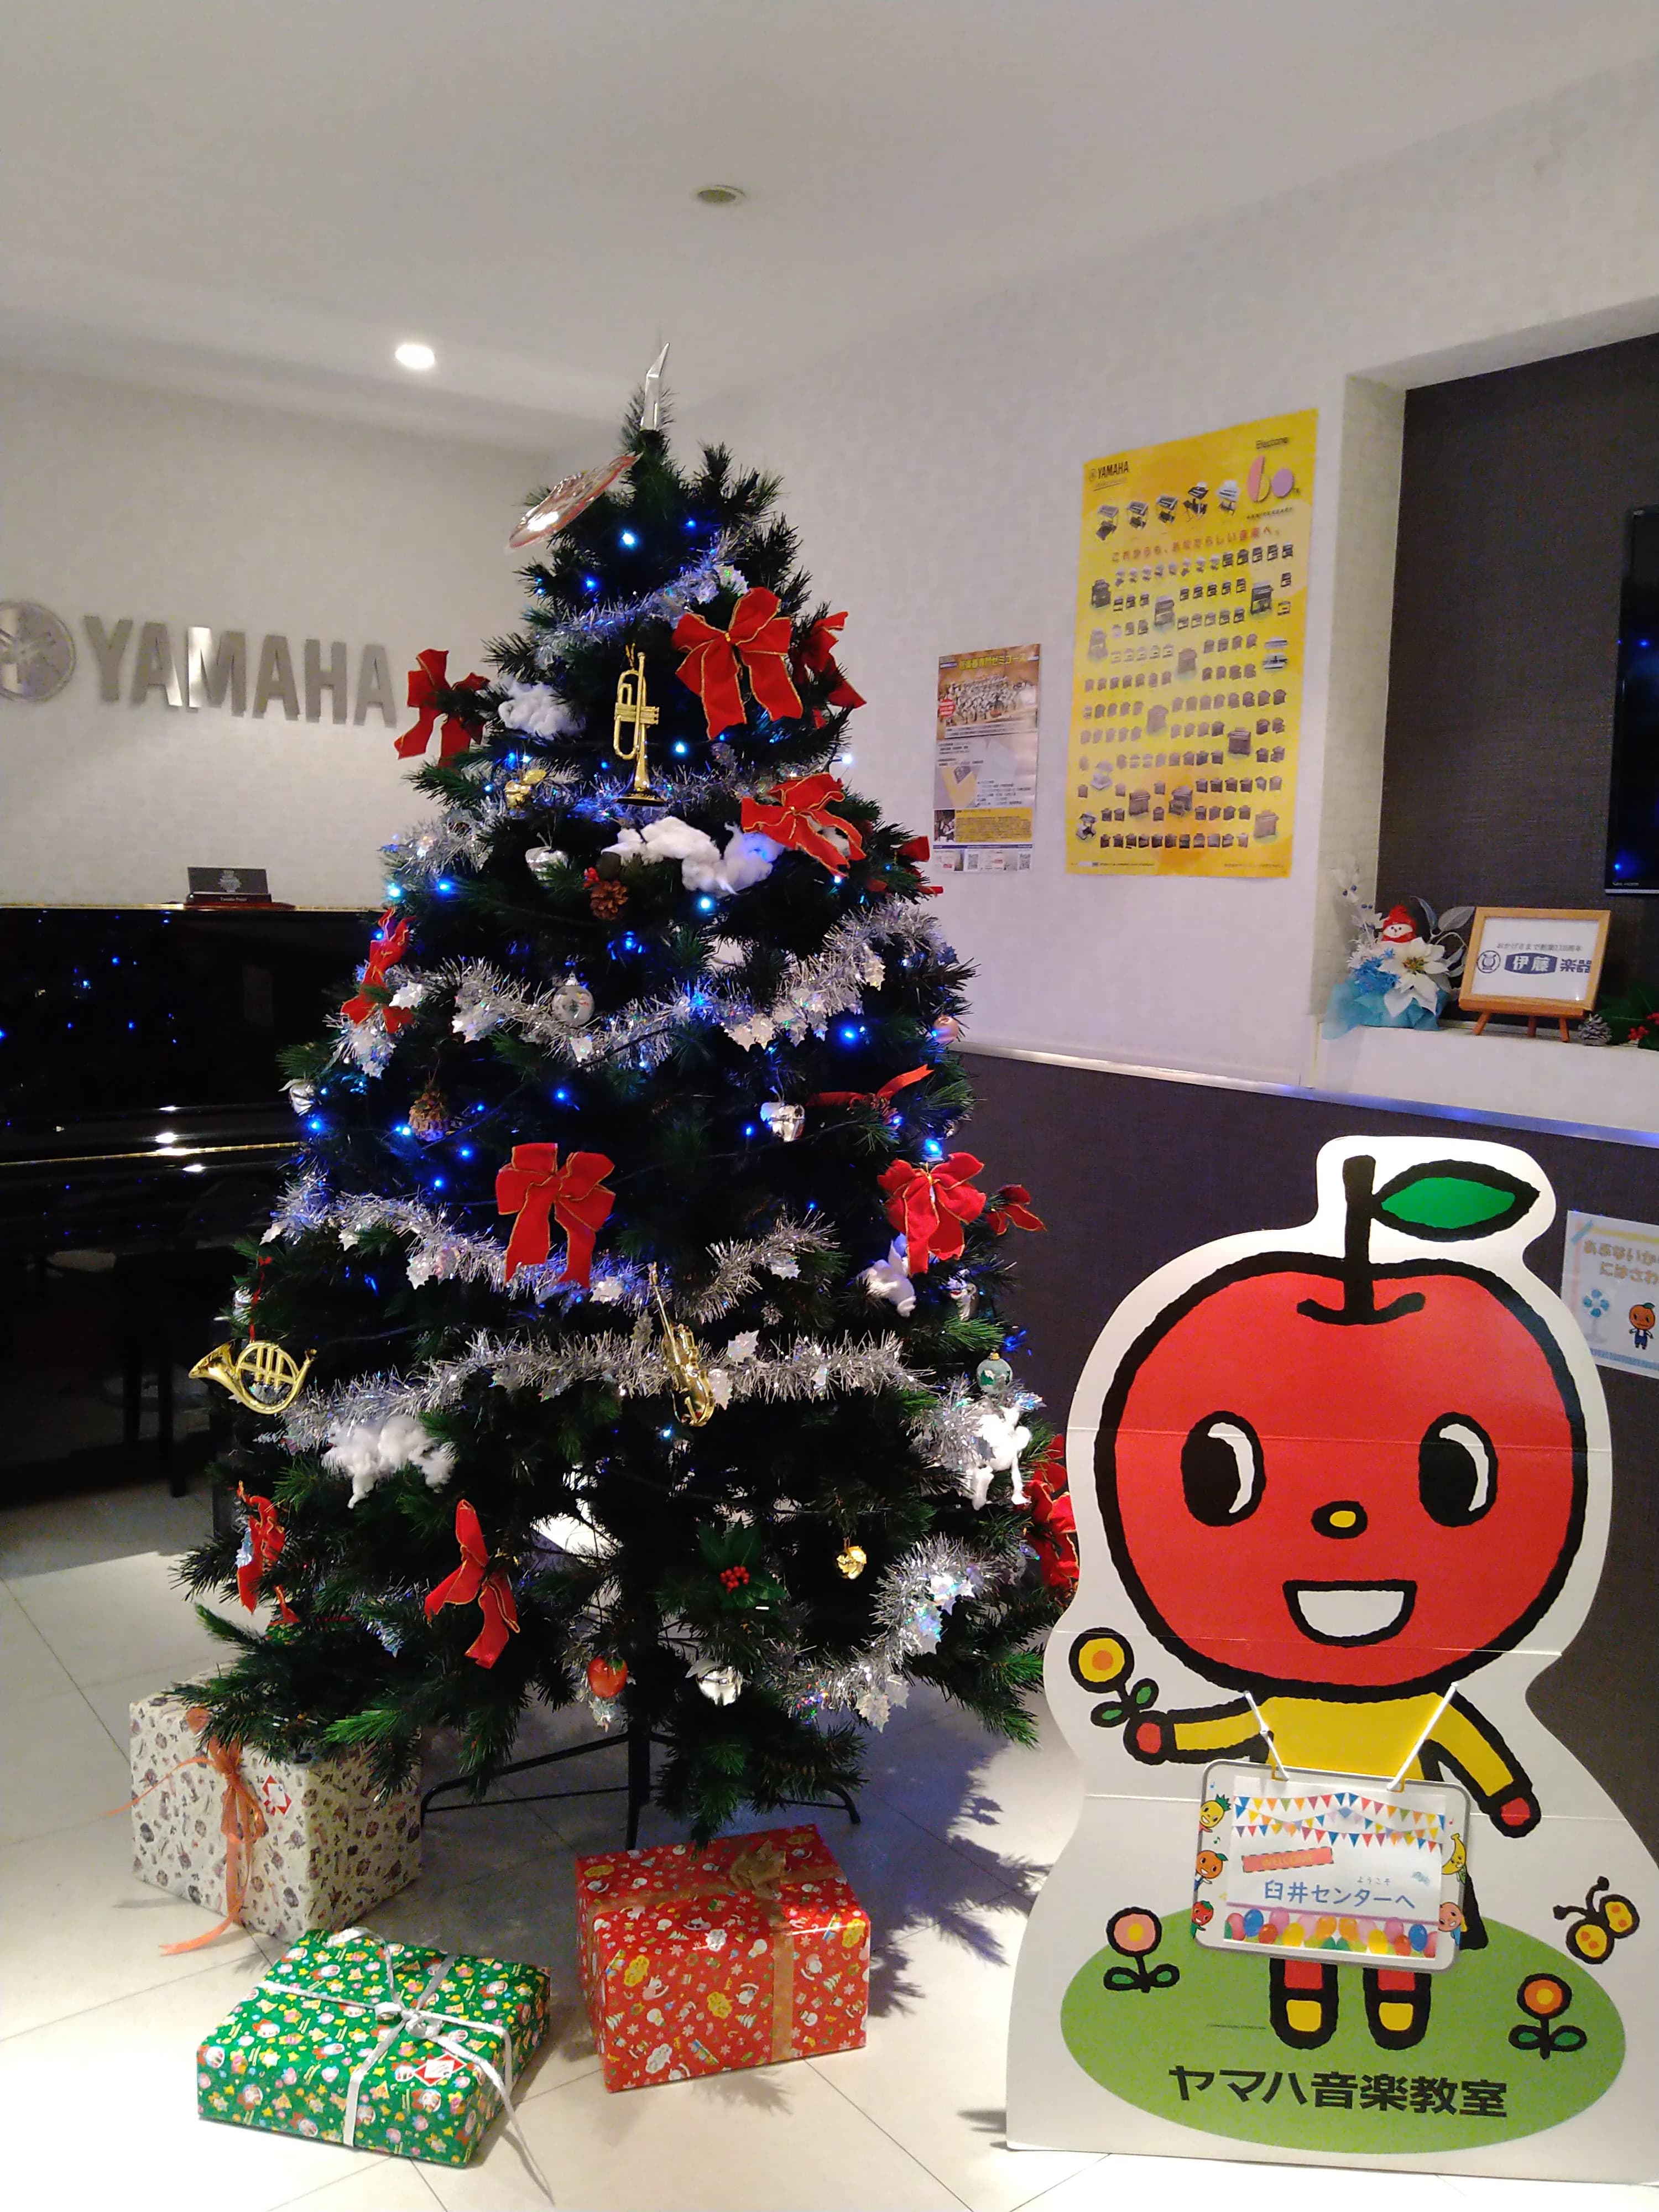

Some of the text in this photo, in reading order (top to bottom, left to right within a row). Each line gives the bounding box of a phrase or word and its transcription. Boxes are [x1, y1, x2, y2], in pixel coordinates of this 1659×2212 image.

[1098, 461, 1129, 479] YAMAHA
[84, 615, 397, 728] YAMAHA
[1260, 1853, 1314, 1867] WELCOME
[1357, 1875, 1391, 1886] ようこそ
[1264, 1880, 1416, 1909] 臼井センターへ
[1168, 2065, 1507, 2118] ヤマハ音楽教室
